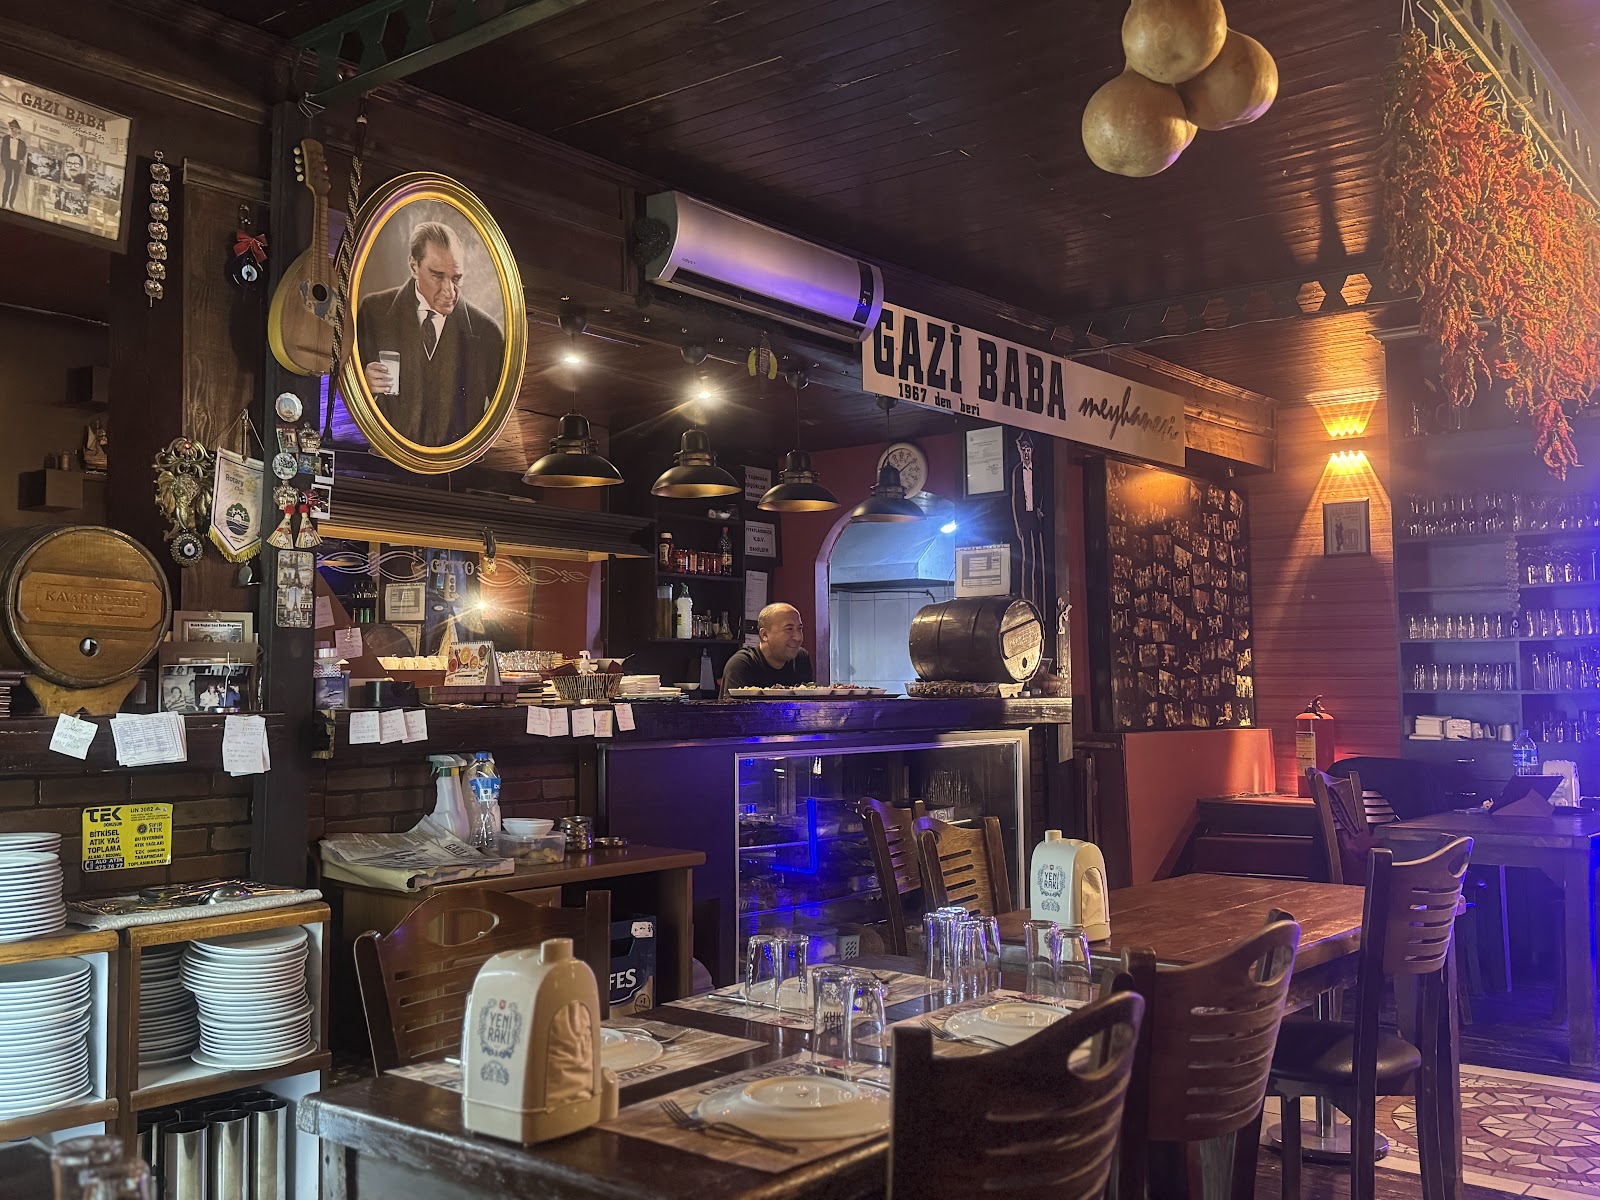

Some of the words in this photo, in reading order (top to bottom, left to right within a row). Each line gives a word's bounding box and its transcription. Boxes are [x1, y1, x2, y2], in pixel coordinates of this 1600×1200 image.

[64, 106, 107, 132] BABA
[873, 308, 962, 394] GAZİ
[978, 338, 1066, 421] BABA
[1078, 386, 1180, 440] meyhanesi
[898, 382, 927, 403] 1967
[934, 391, 952, 409] den
[959, 398, 980, 416] beri
[431, 558, 475, 576] GETTO
[86, 807, 122, 823] TEK
[89, 829, 120, 838] BİTKİSEL
[89, 838, 105, 846] ATIK
[107, 836, 120, 845] YAĞ
[87, 845, 122, 854] TOPLAMA
[1043, 880, 1059, 890] RAKI
[1044, 871, 1060, 882] YENİ
[609, 968, 637, 990] FES
[489, 1011, 514, 1031] YENİ
[487, 1026, 511, 1045] RAKI
